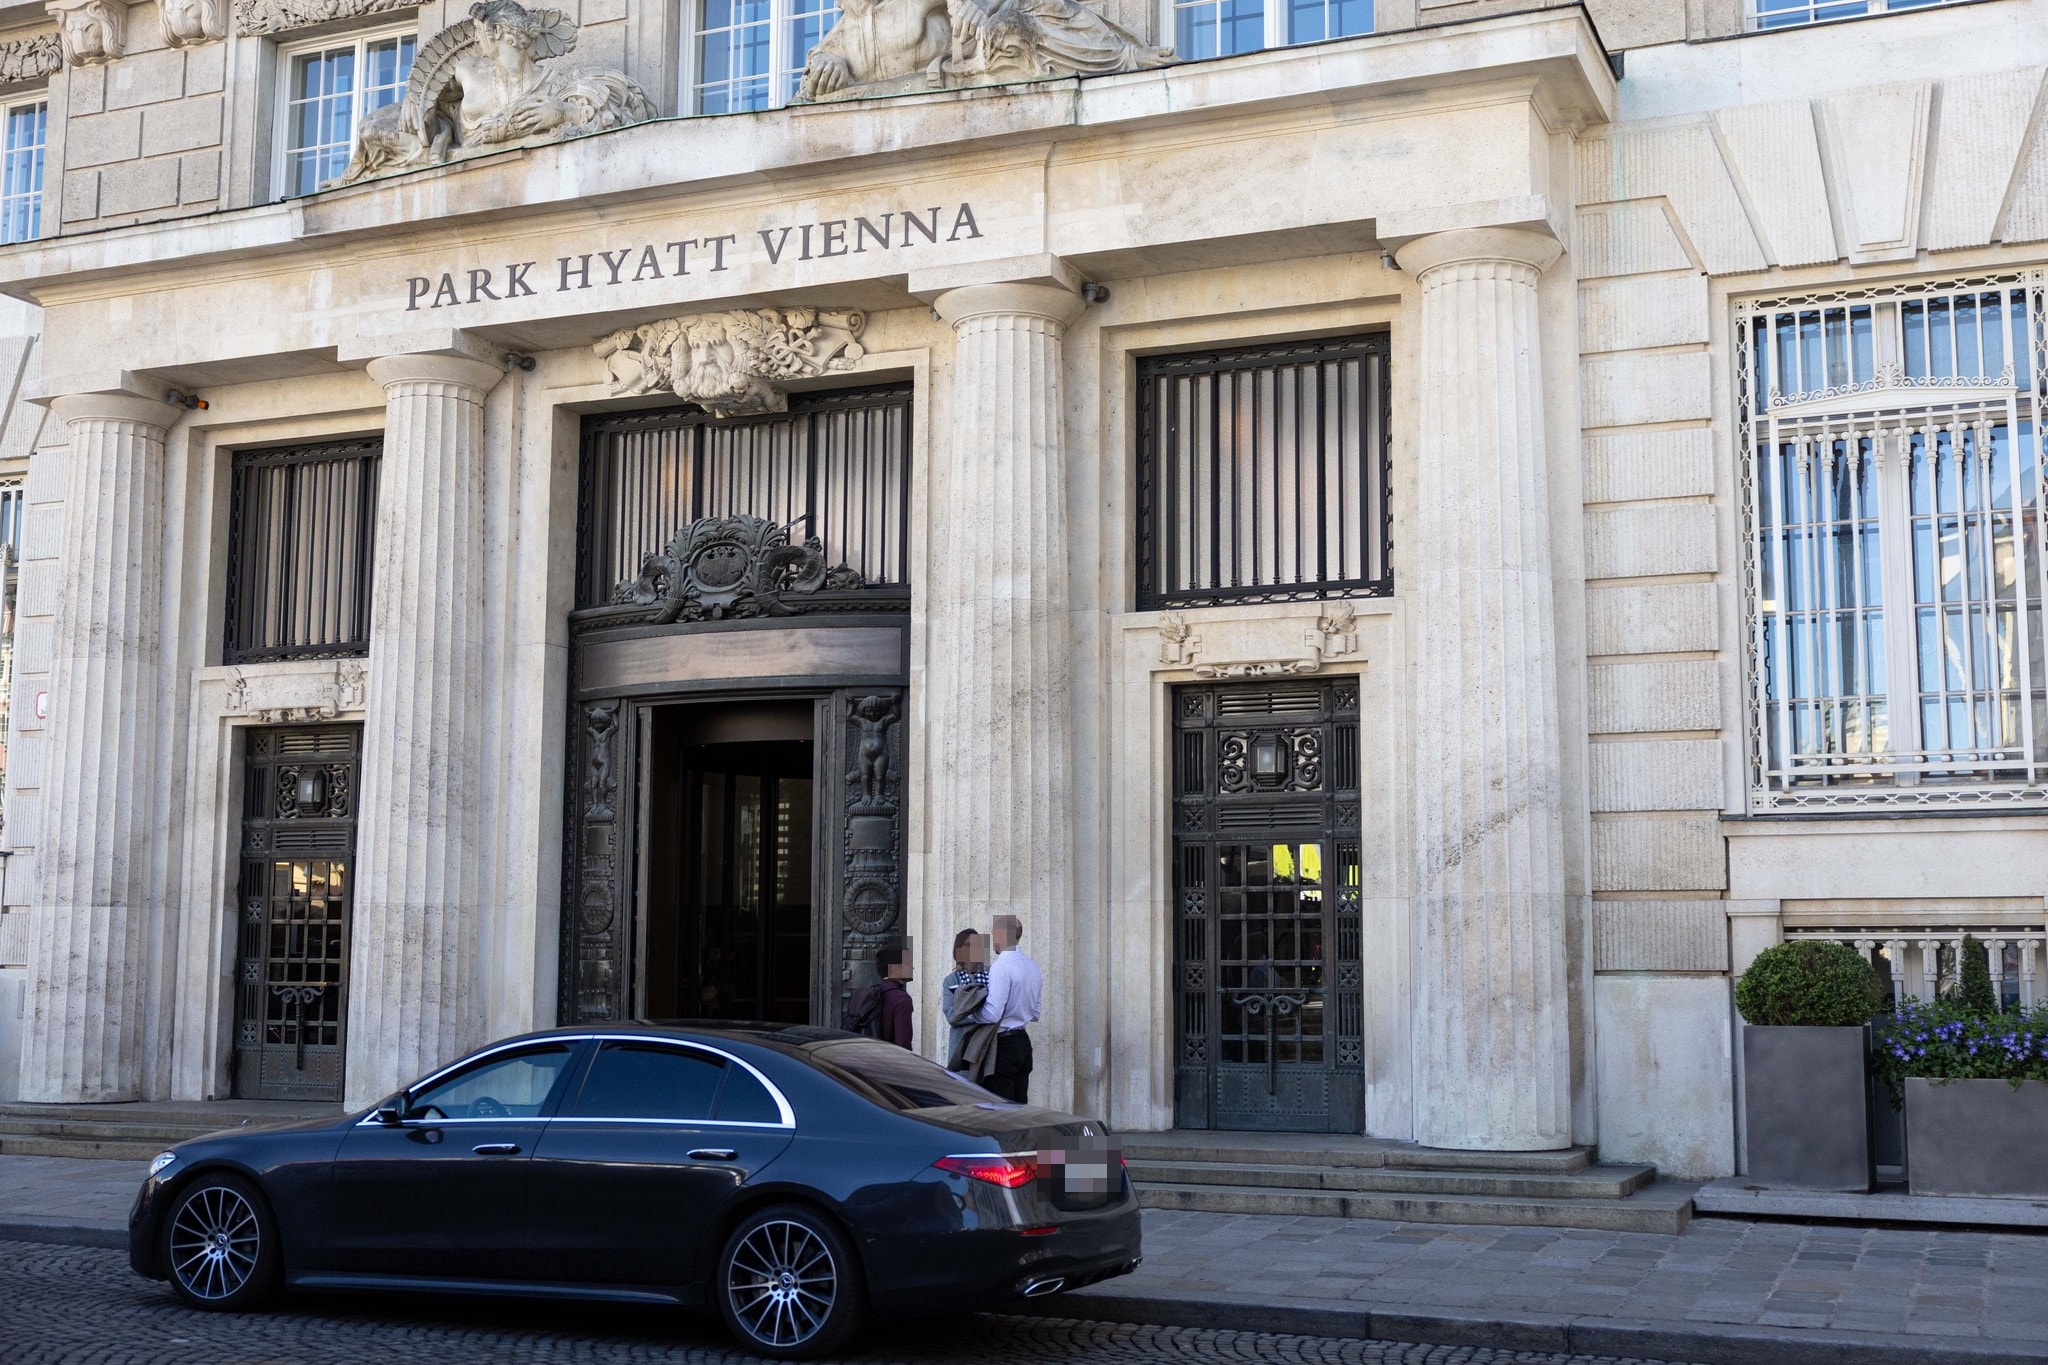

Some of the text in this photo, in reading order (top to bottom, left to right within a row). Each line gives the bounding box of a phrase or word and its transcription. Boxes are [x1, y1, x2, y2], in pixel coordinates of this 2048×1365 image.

[405, 202, 984, 312] PARK HYATT VIENNA
